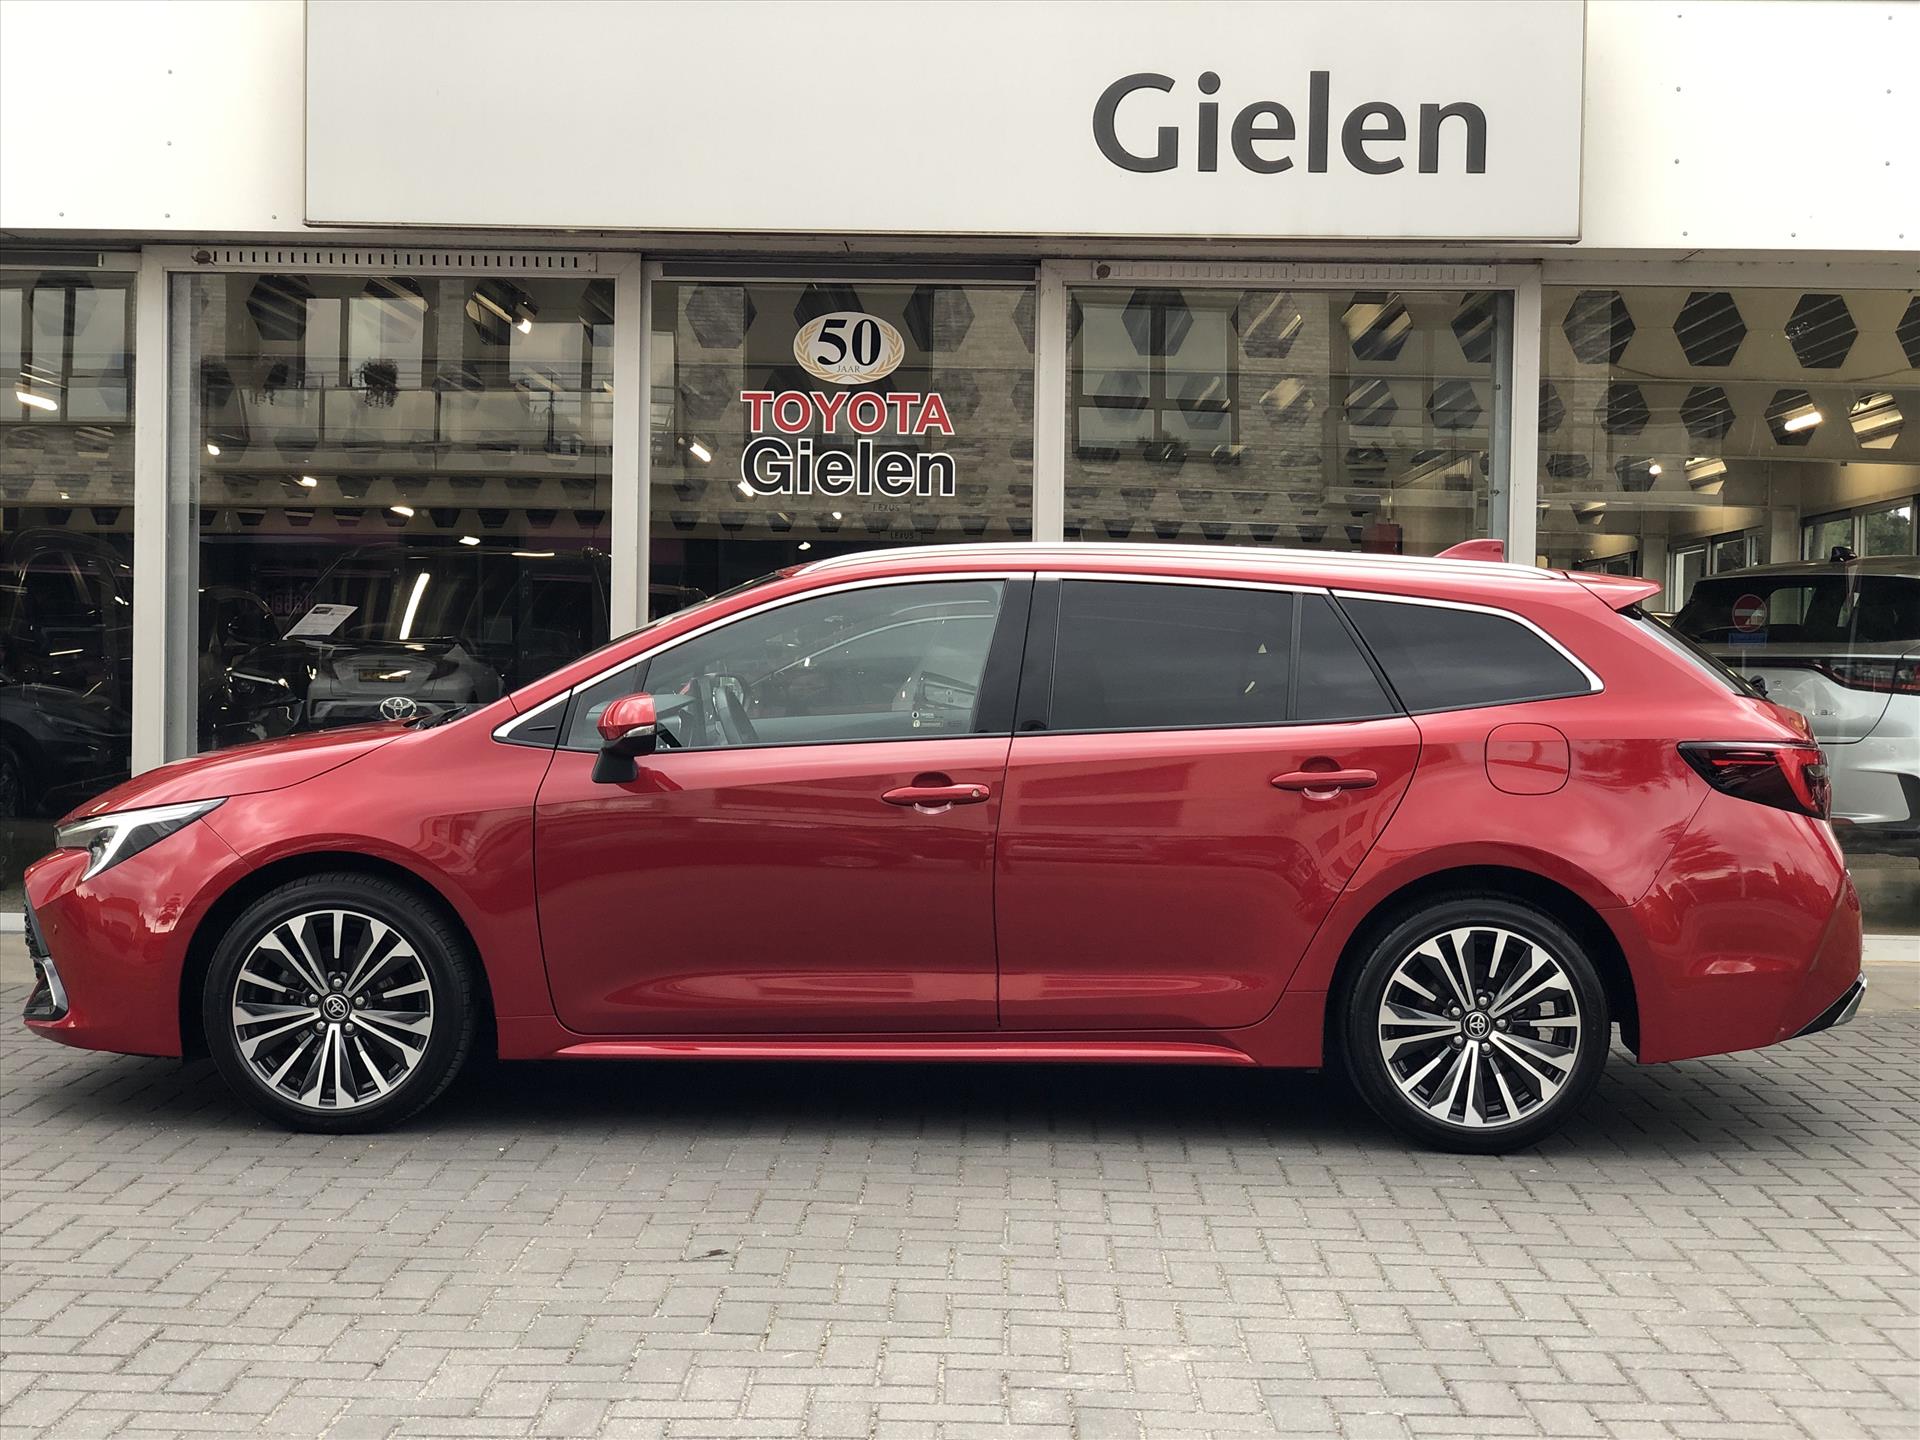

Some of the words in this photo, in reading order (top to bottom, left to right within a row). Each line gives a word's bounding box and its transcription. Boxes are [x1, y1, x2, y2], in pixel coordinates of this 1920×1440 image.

[1093, 71, 1487, 175] Gielen
[817, 319, 882, 366] 50
[837, 365, 861, 373] JAAR
[740, 391, 955, 435] TOYOTA
[741, 436, 956, 497] Gielen
